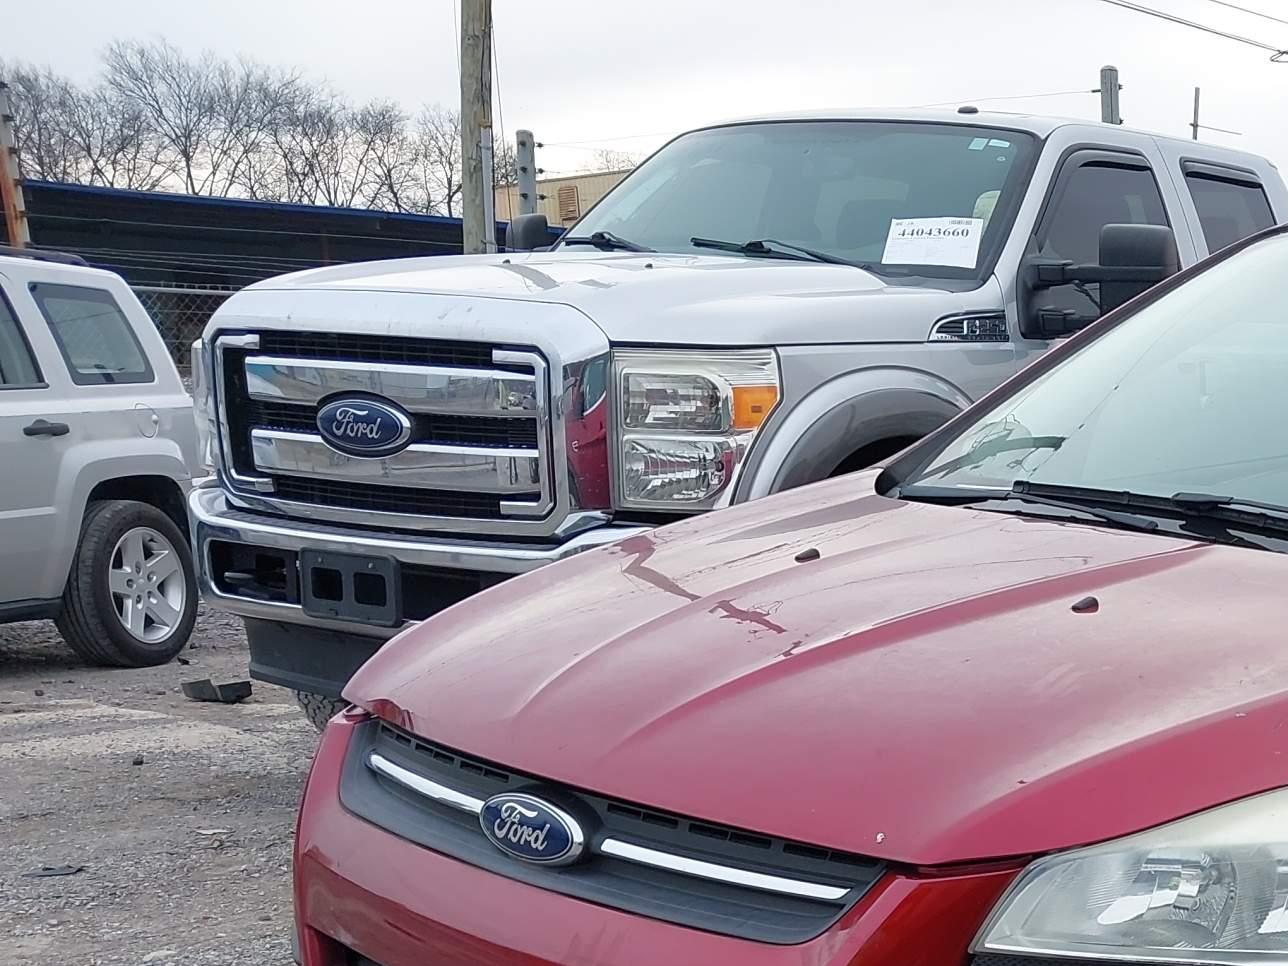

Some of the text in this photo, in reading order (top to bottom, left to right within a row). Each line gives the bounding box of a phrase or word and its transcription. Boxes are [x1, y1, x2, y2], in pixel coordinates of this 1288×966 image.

[897, 227, 970, 238] 44043660
[332, 407, 382, 439] Ford
[493, 802, 551, 851] Ford
